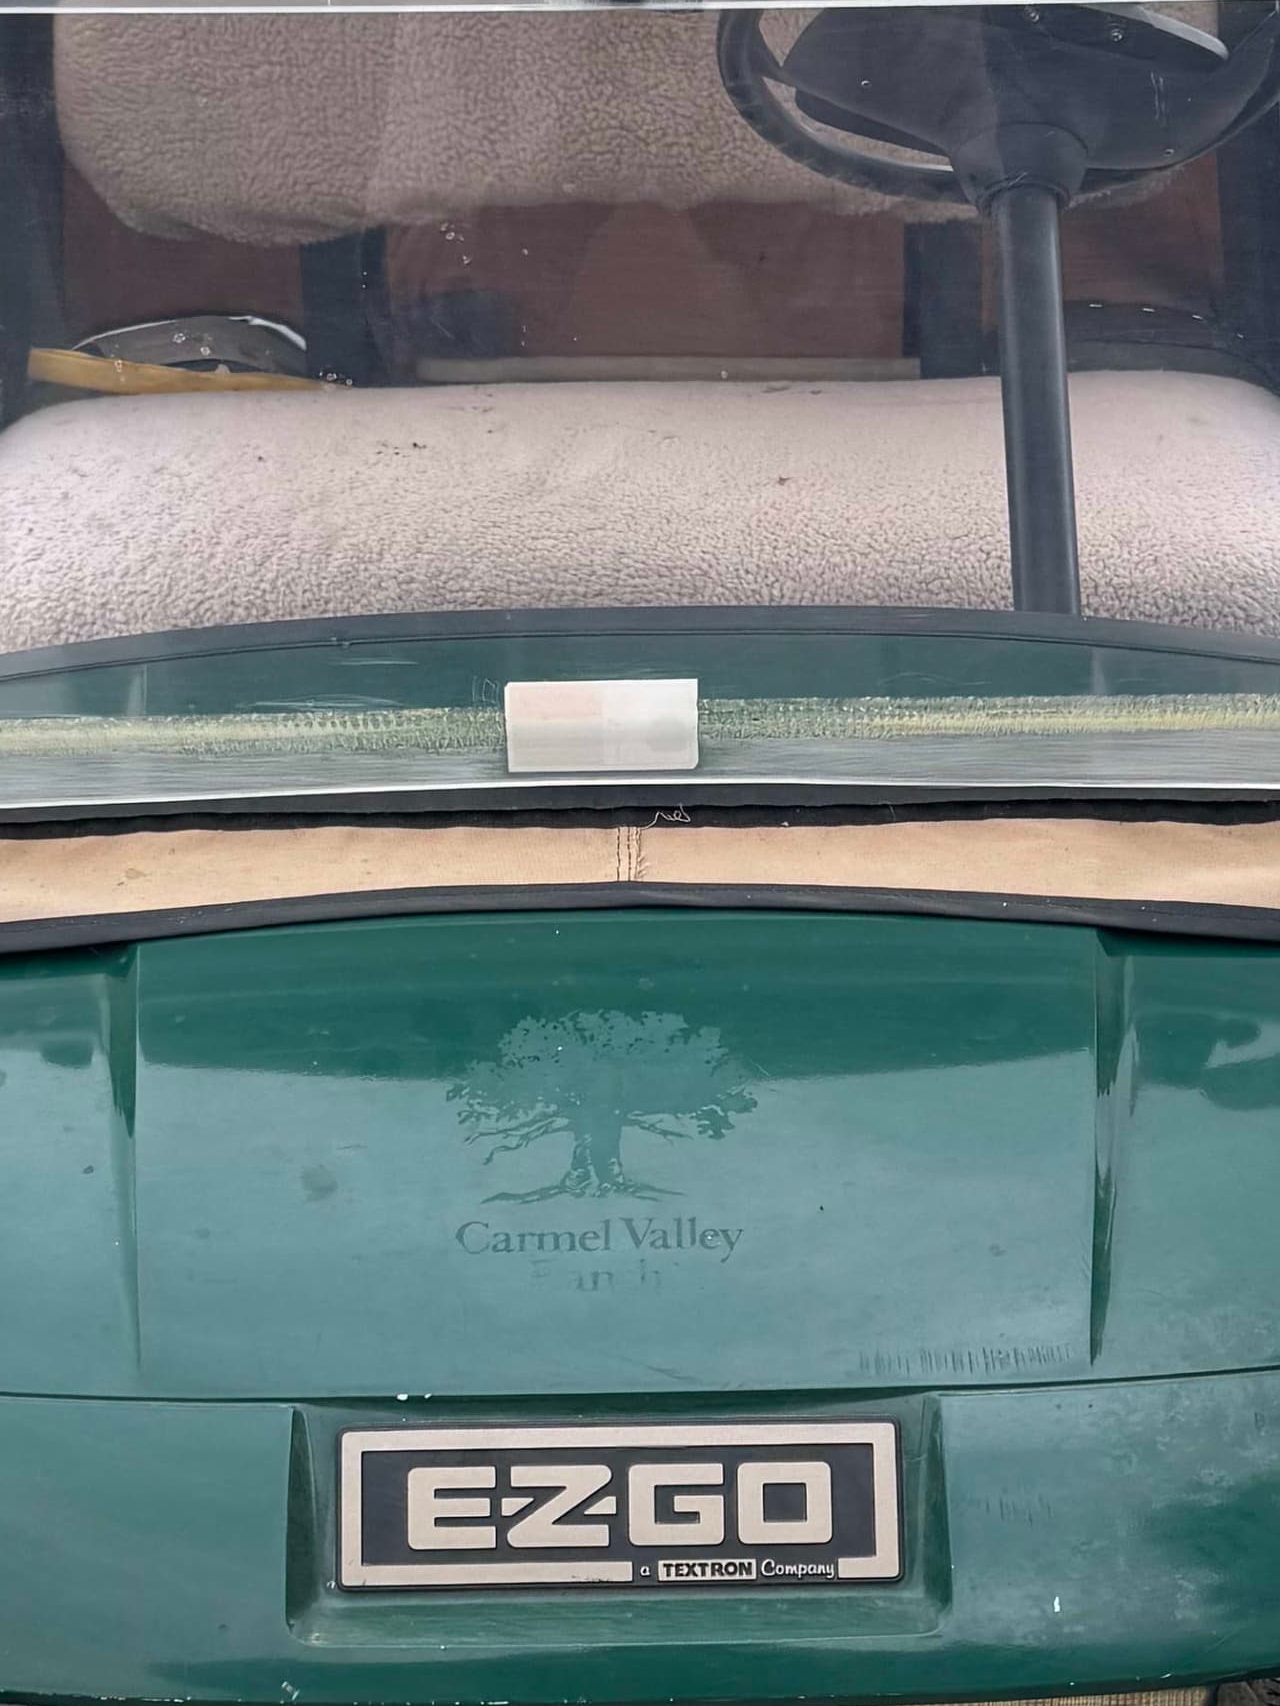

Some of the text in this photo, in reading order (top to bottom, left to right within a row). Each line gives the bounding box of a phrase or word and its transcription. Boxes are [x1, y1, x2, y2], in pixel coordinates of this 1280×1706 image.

[455, 1216, 745, 1263] Carmel Valley
[640, 1558, 835, 1579] a TEXTRON Company
